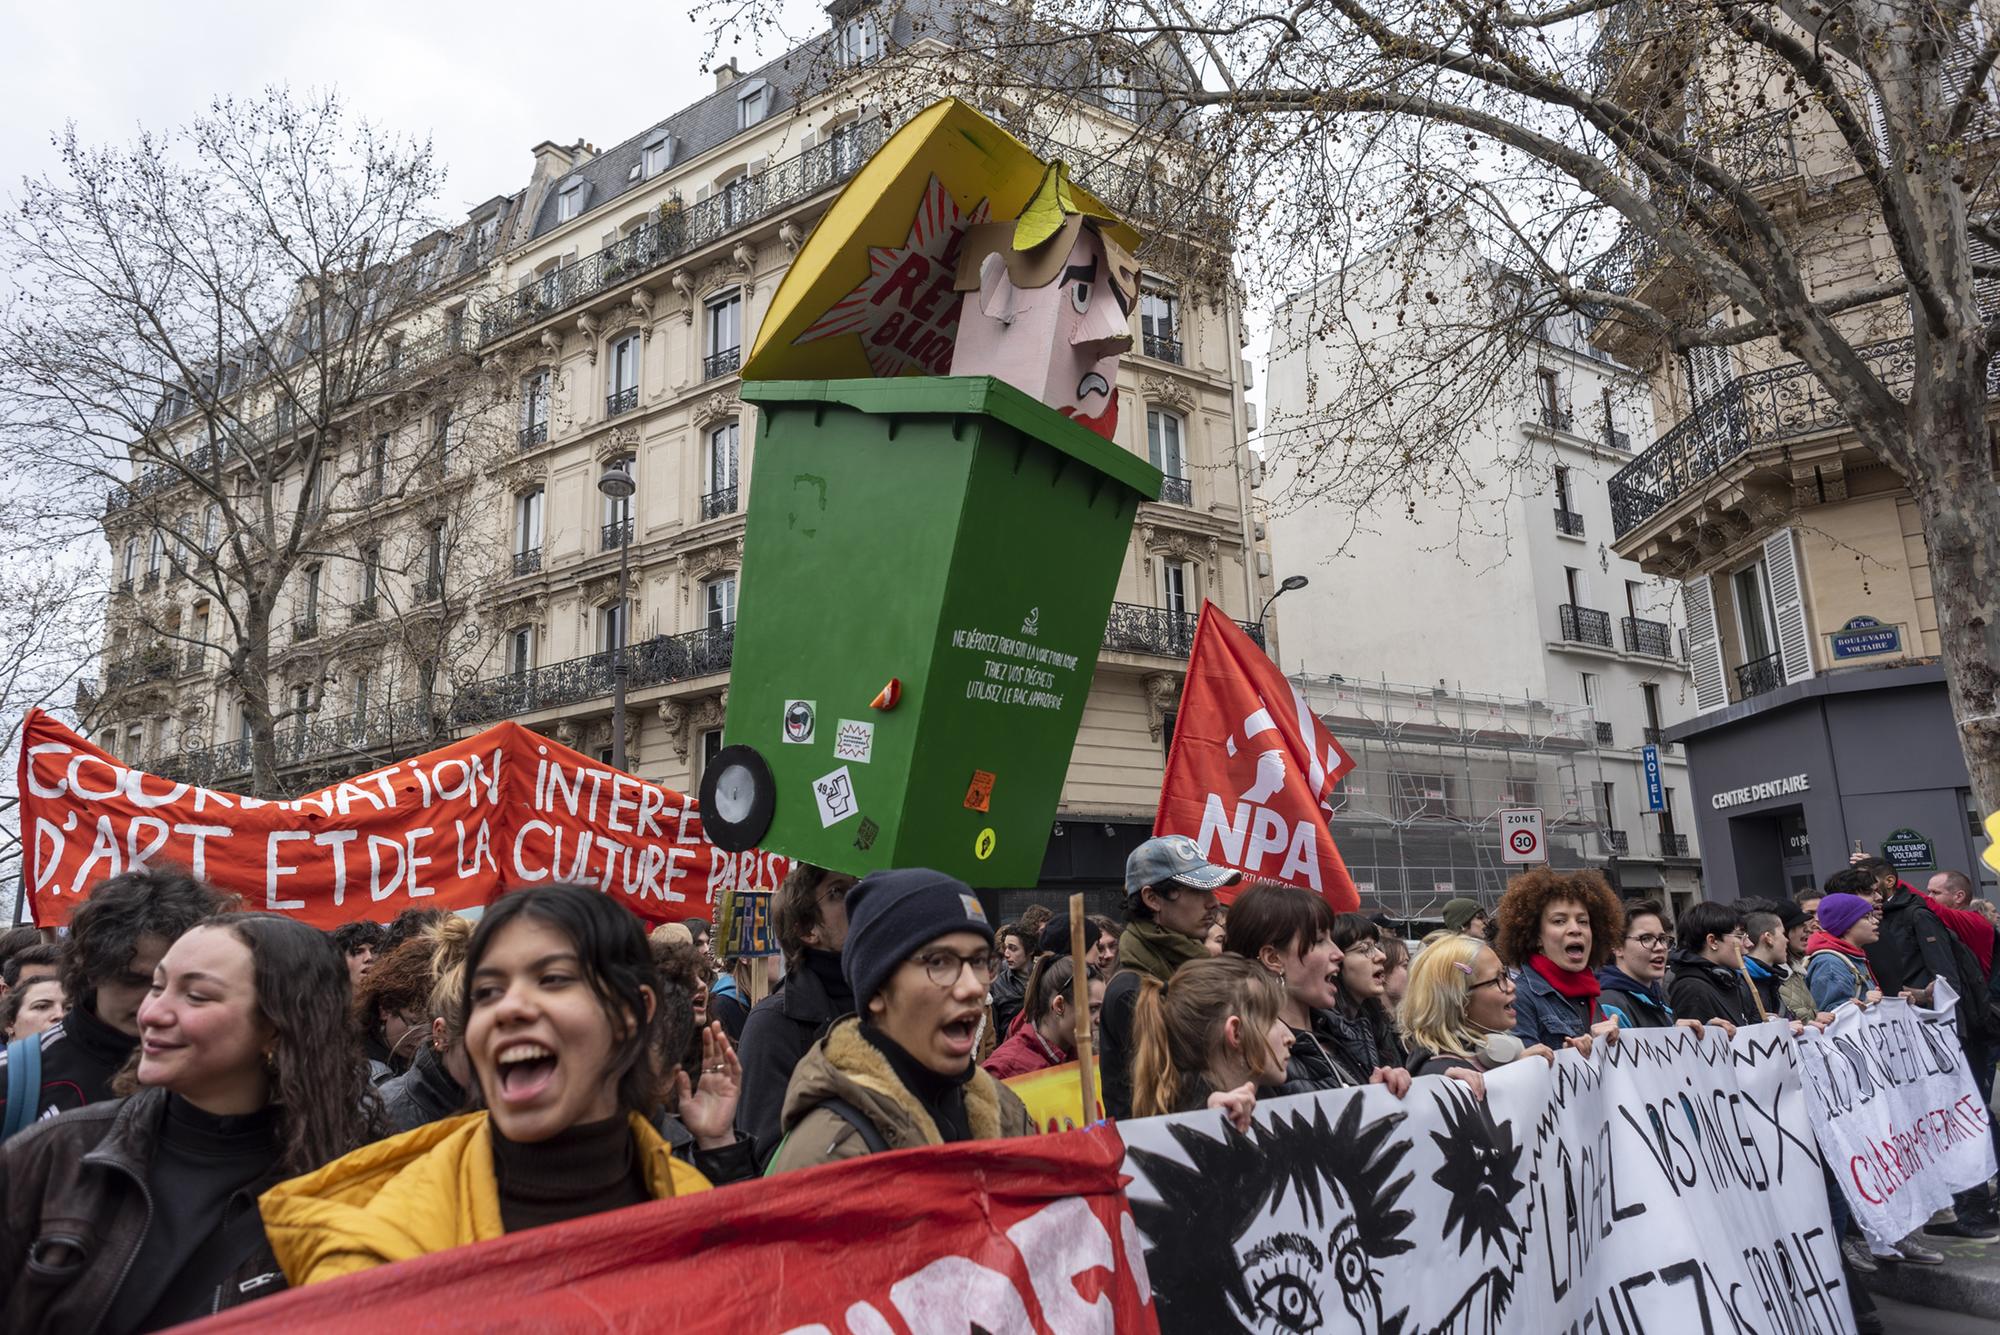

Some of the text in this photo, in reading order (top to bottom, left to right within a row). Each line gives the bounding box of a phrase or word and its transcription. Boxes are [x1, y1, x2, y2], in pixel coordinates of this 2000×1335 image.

[952, 629, 967, 647] NE
[966, 628, 998, 652] DÉPOSEZ
[1021, 625, 1038, 637] PARIS
[1838, 632, 1893, 646] BOULEVARD
[1847, 642, 1888, 653] VOLTAIRE
[984, 660, 1056, 689] TRIEZ VOS DÉCHETS
[966, 680, 1064, 711] UTILISEZ LE BAC APPROPRIÉ
[1646, 751, 1660, 804] HOTEL
[1712, 773, 1811, 809] CENTRE DENTAIRE
[1508, 815, 1536, 824] ZONE
[1198, 792, 1323, 893] NPA
[1515, 836, 1532, 848] 30
[1887, 843, 1927, 852] BOULEVARD
[456, 818, 497, 880] LA
[513, 819, 696, 903] CULTURE
[1893, 850, 1924, 859] VOLTAIRE
